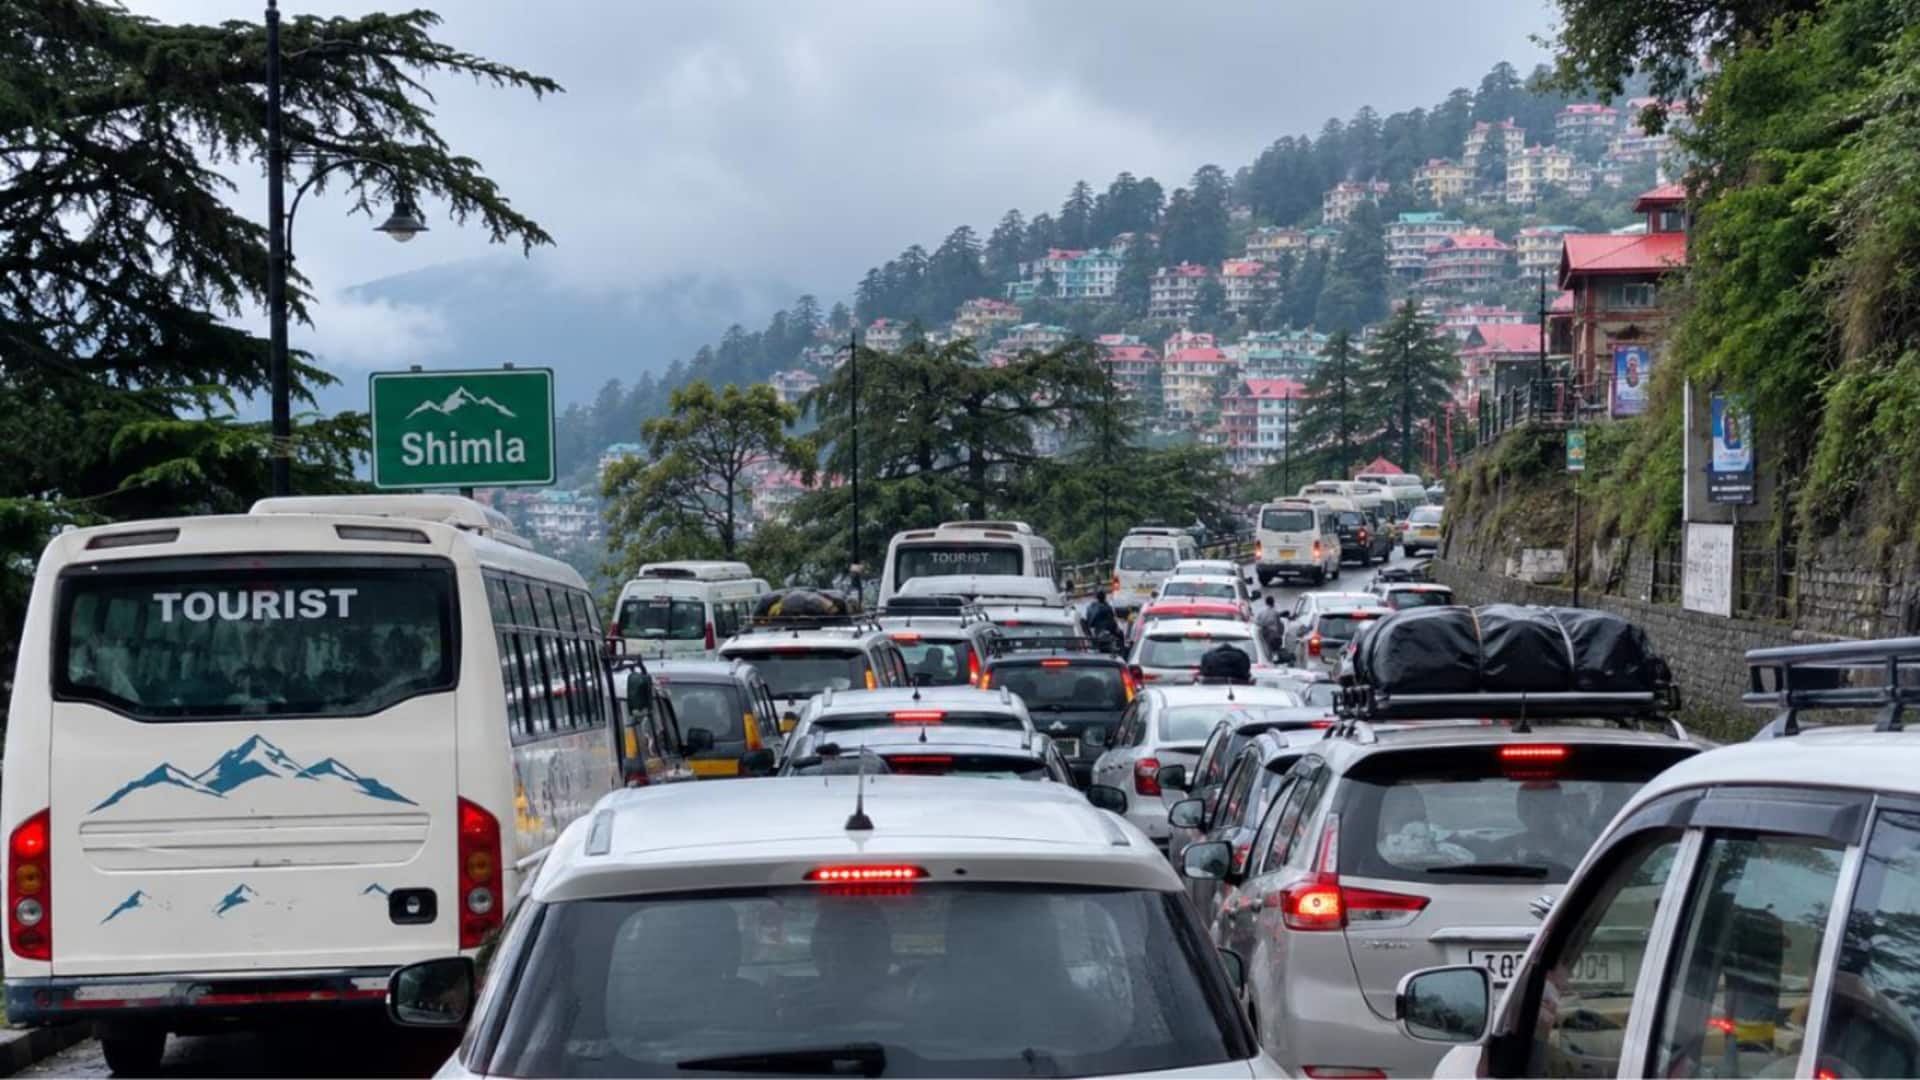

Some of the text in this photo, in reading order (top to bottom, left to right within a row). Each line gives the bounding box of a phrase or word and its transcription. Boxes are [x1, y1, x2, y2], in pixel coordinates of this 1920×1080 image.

[402, 429, 526, 466] Shimla
[931, 551, 989, 563] TOURIST
[153, 588, 358, 623] TOURIST
